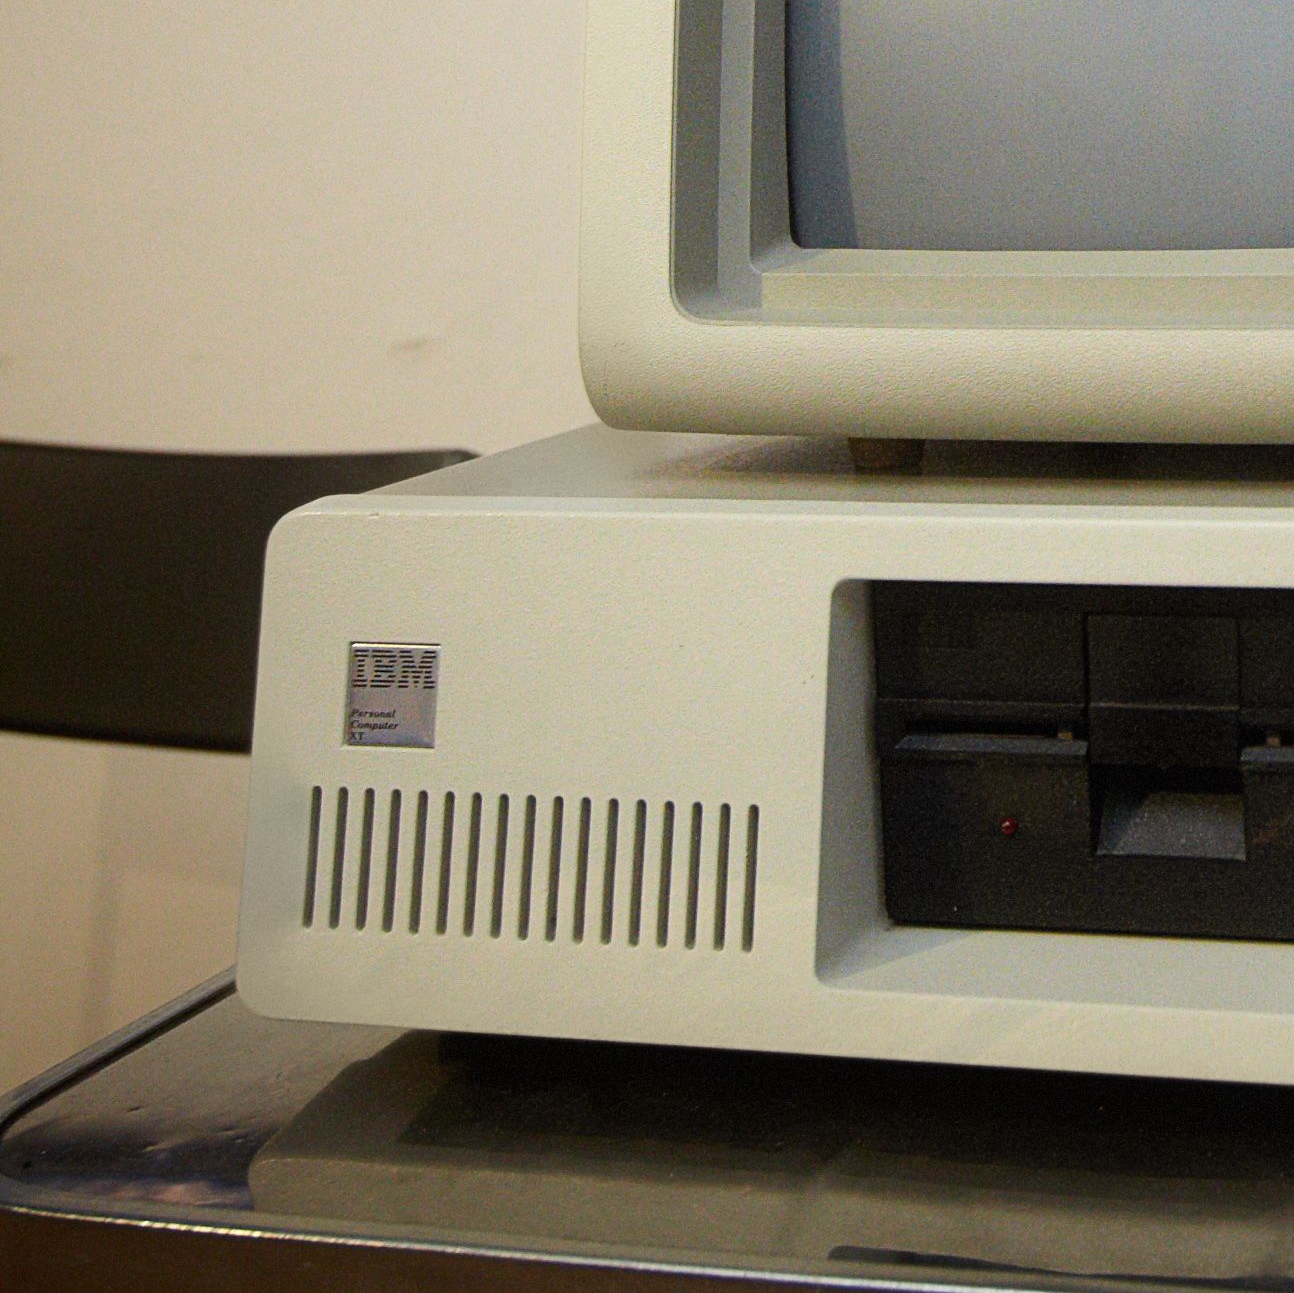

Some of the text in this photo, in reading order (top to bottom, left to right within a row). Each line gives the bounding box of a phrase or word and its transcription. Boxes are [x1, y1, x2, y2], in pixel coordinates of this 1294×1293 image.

[352, 649, 437, 689] IBM
[350, 707, 397, 718] Personal
[350, 719, 399, 731] Computer
[350, 731, 365, 740] XT
